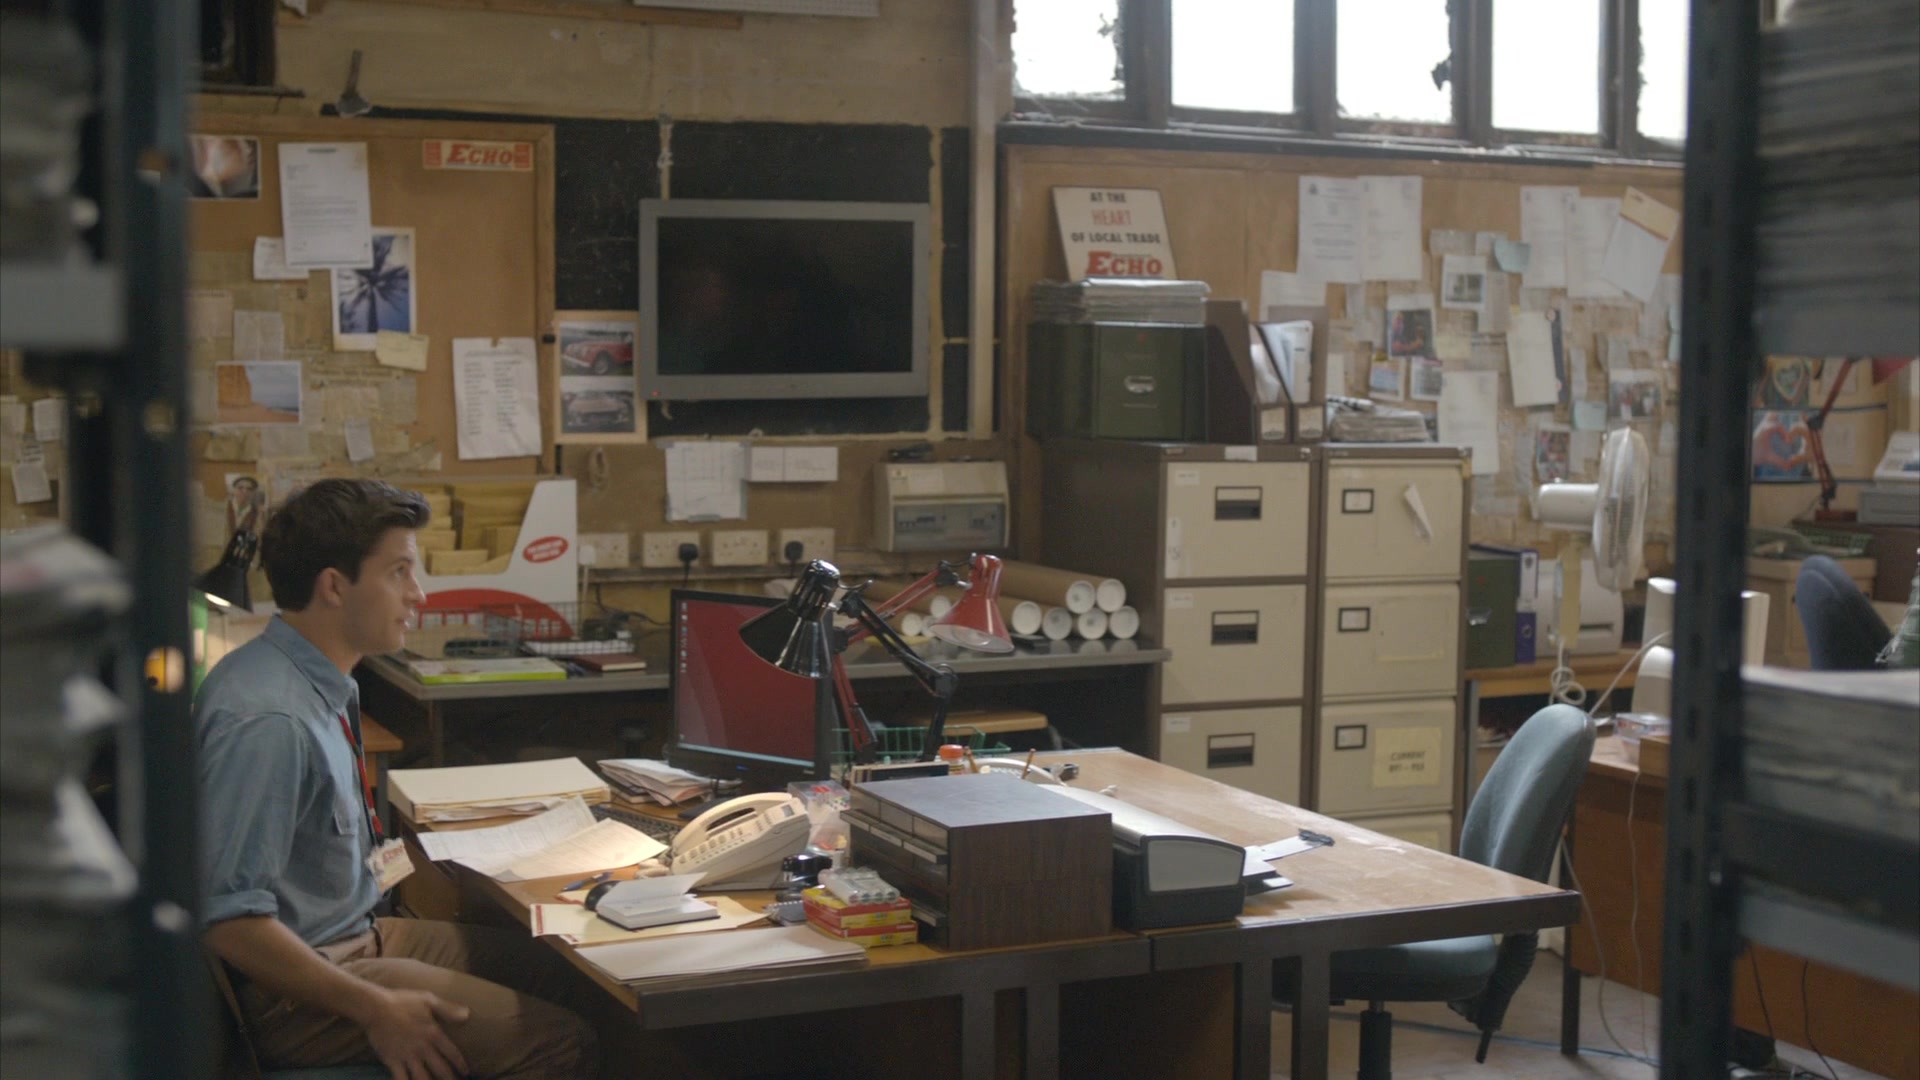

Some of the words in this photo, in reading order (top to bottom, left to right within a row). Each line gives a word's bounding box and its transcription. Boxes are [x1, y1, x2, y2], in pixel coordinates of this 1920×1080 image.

[447, 143, 513, 165] ECHO
[1090, 192, 1104, 202] AT
[1107, 192, 1126, 203] THE
[1091, 208, 1131, 226] HEART
[1071, 232, 1086, 242] OF
[1089, 232, 1122, 243] LOCAL
[1125, 232, 1161, 243] TRADE
[1086, 251, 1163, 275] ECHO
